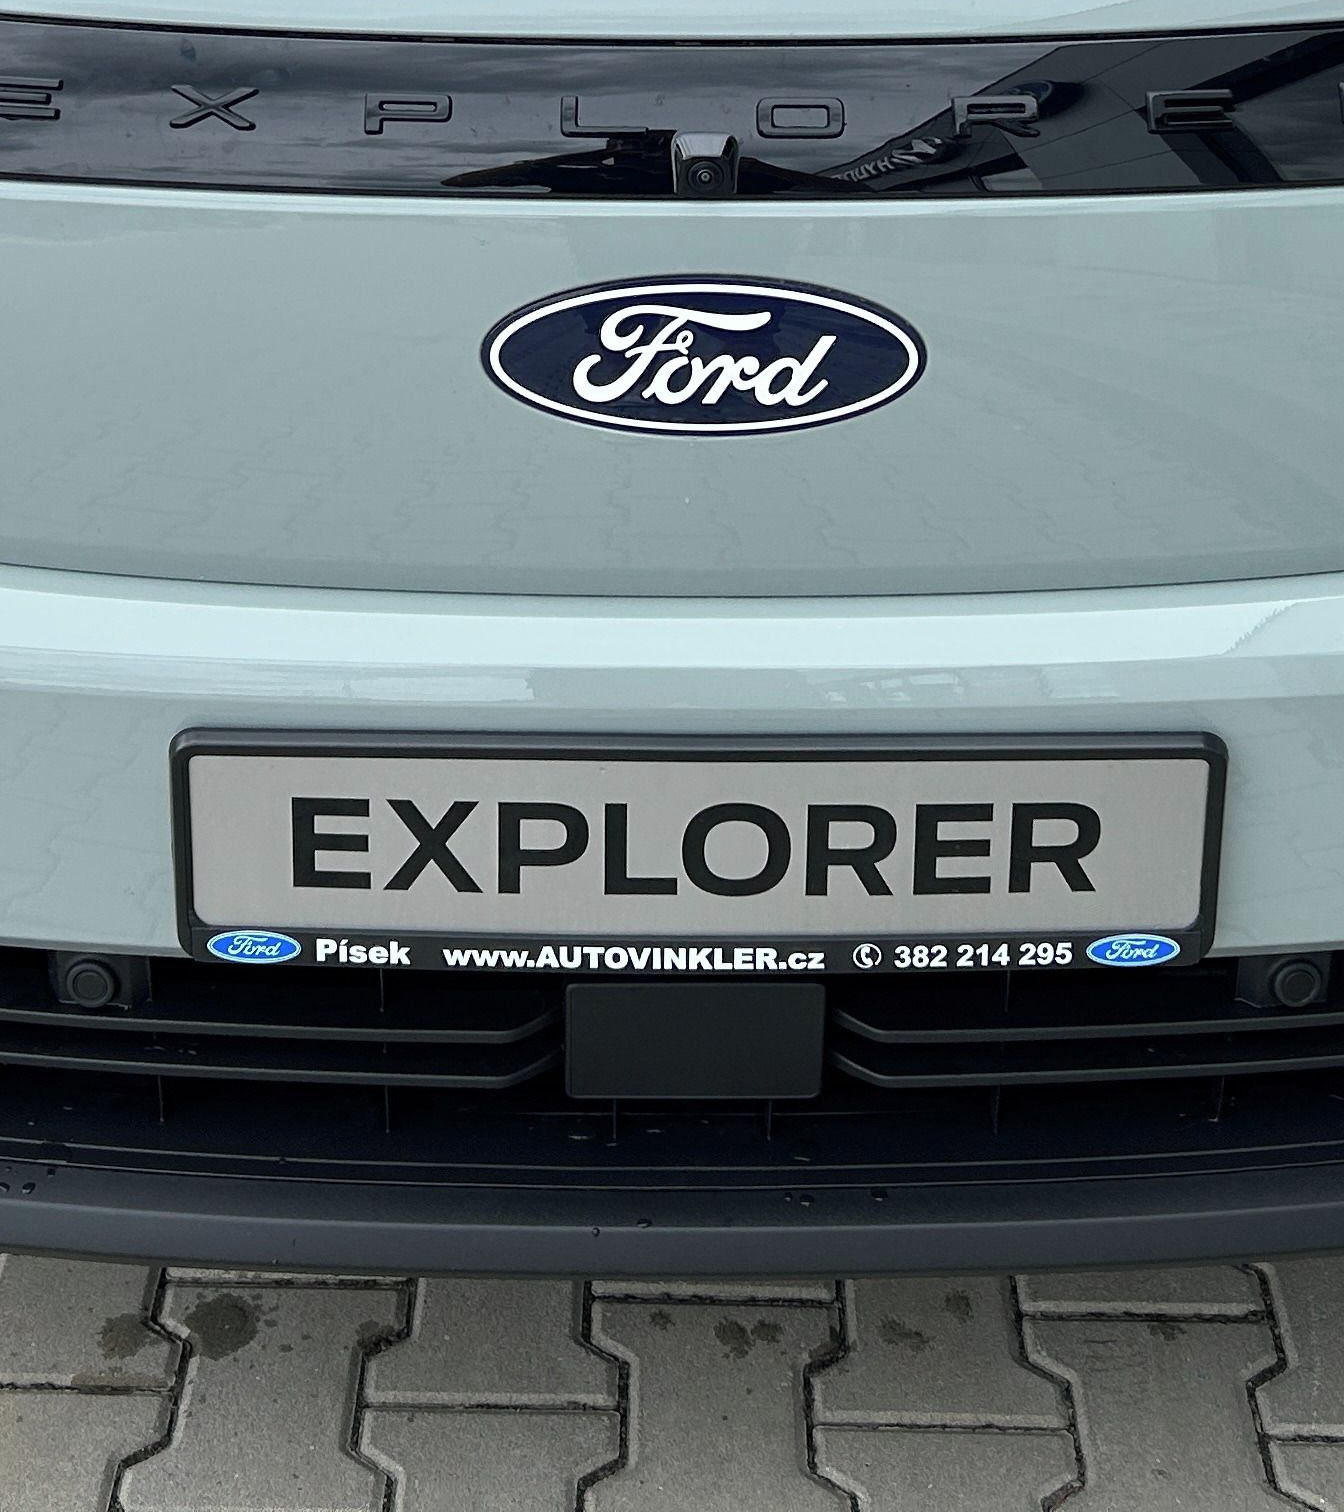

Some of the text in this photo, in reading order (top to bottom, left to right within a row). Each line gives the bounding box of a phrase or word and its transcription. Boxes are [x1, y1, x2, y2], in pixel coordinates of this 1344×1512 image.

[573, 304, 837, 406] Ford
[290, 797, 1102, 897] EXPLORER
[226, 935, 282, 959] Ford
[315, 938, 1073, 971] Písek www.AUTOVINKLER.cz 382 214 295
[1104, 938, 1160, 961] Ford
